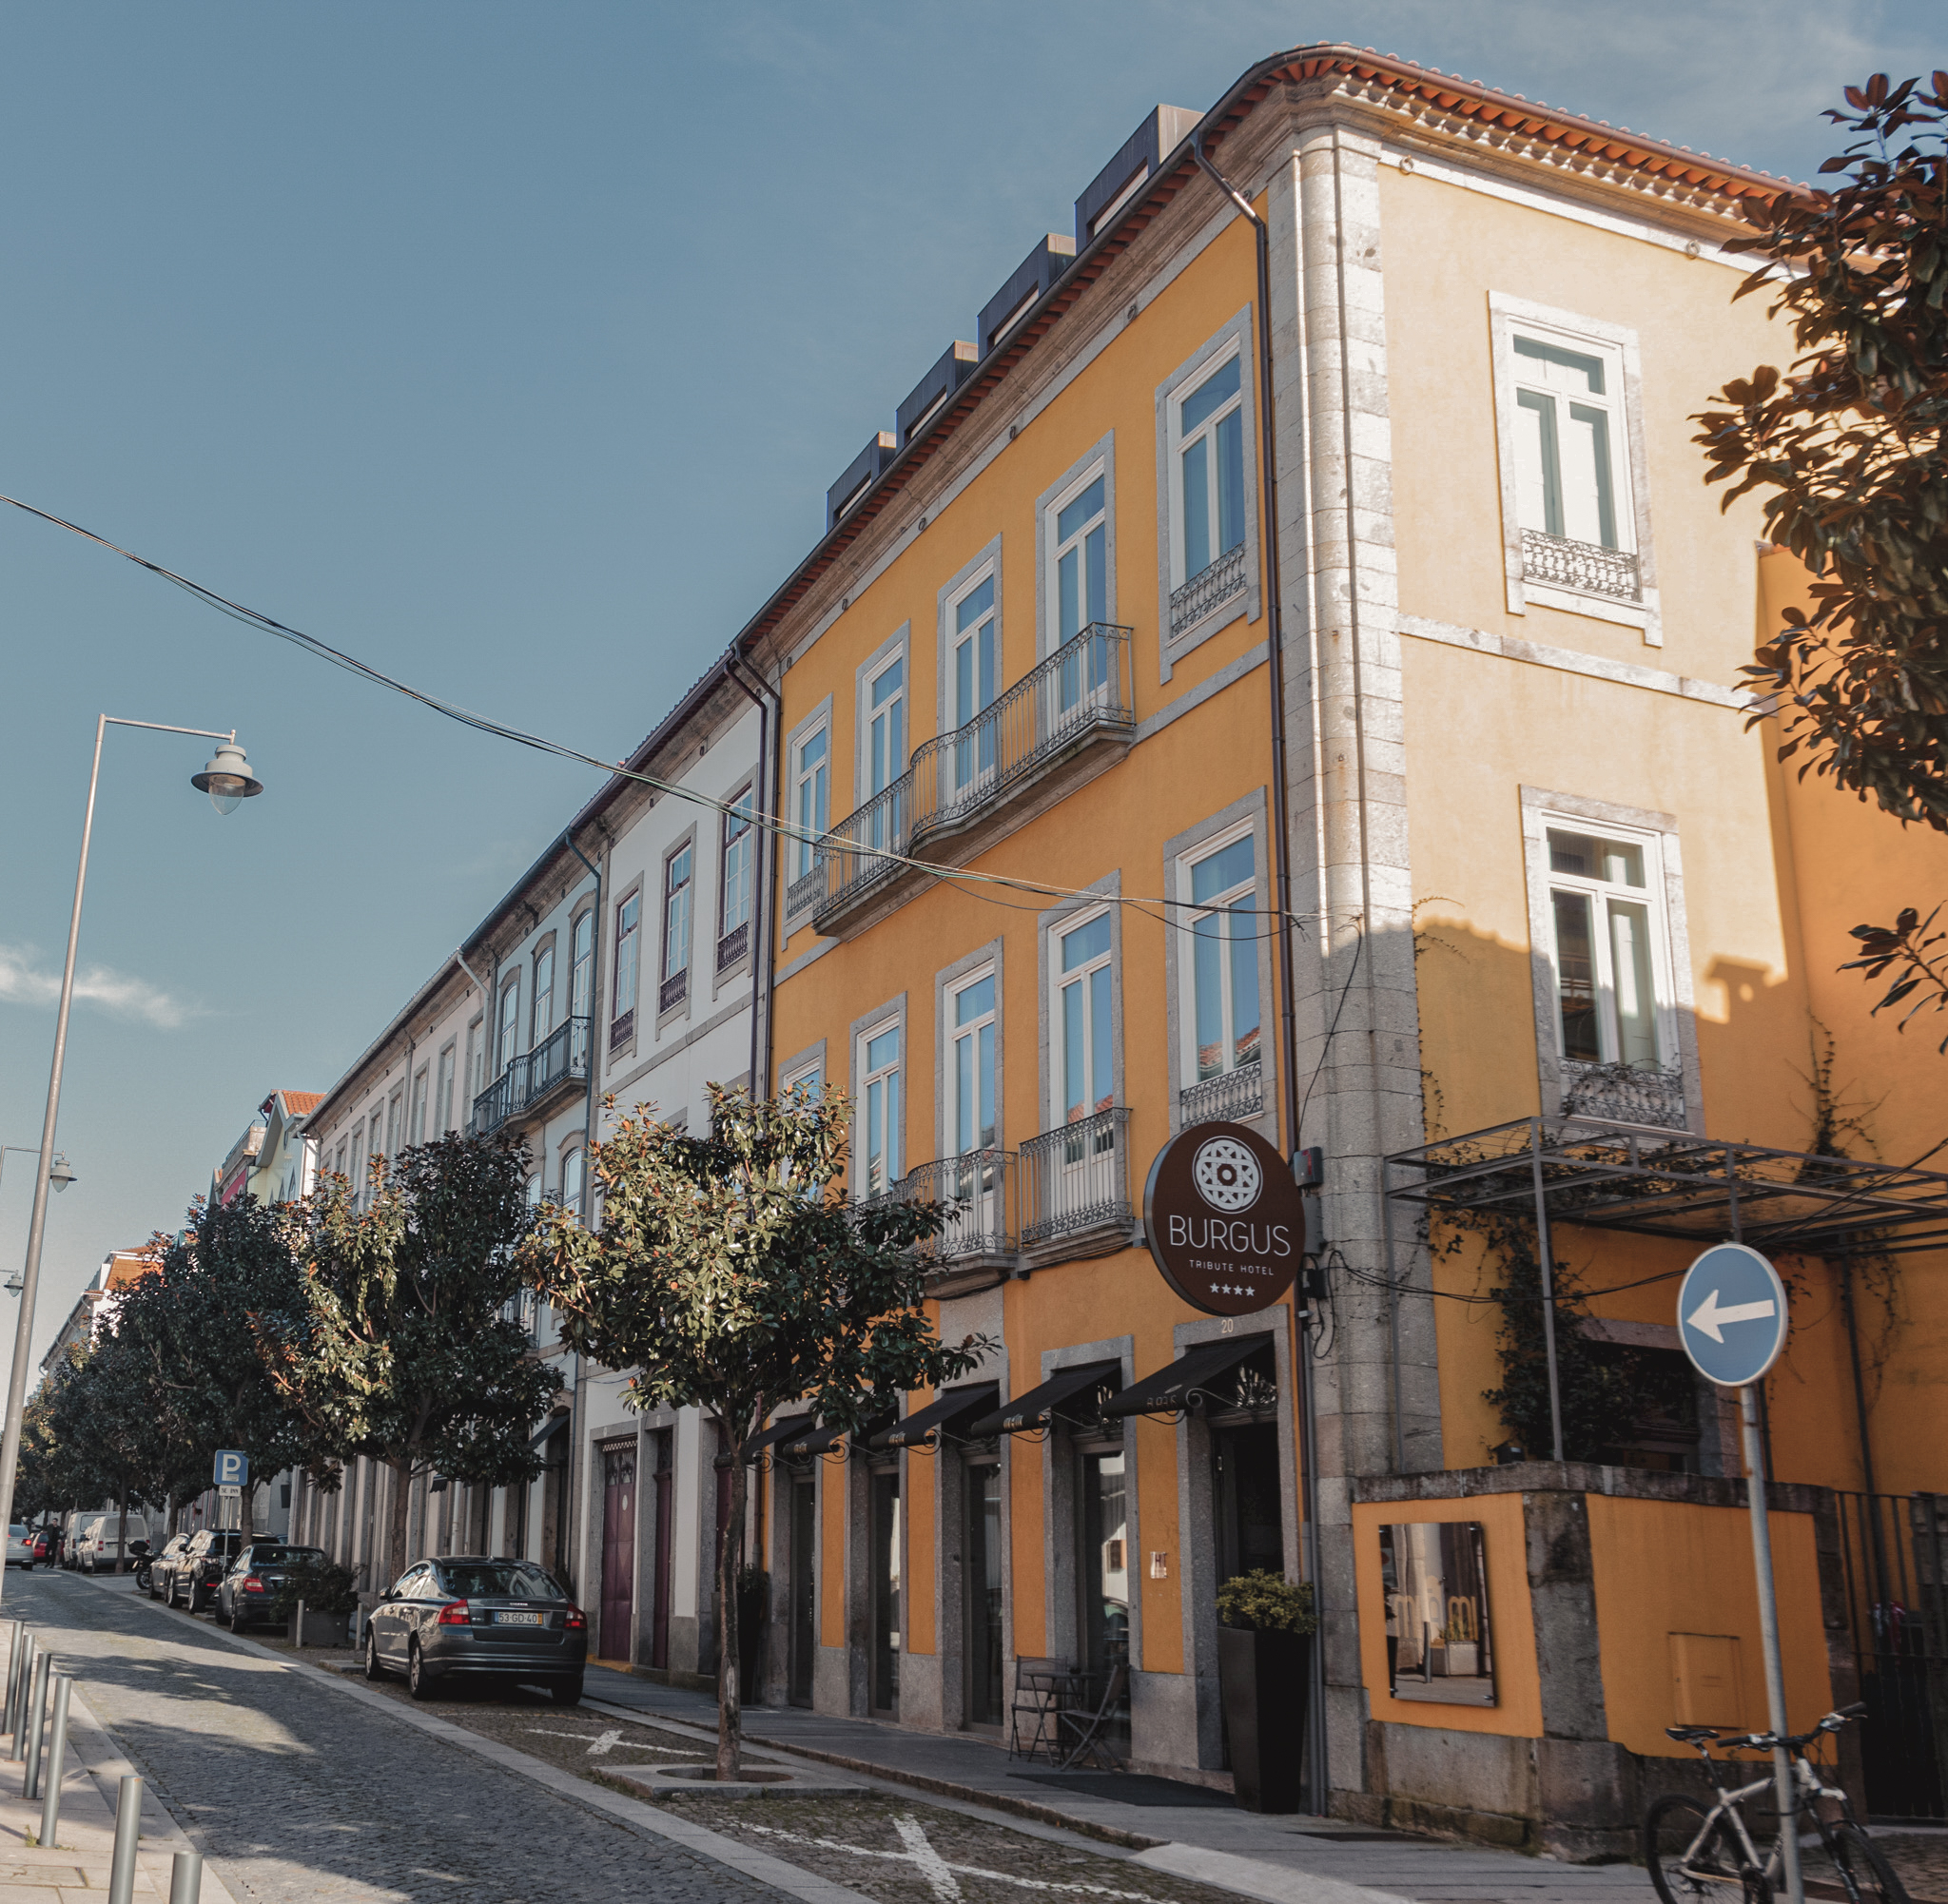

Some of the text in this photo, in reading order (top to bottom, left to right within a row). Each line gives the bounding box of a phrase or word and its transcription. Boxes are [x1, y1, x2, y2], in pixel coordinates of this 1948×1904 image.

[1169, 1214, 1291, 1257] BURGUS
[1189, 1259, 1275, 1276] TRIBUTE HOTEL
[1221, 1318, 1234, 1333] 20
[222, 1453, 241, 1482] P
